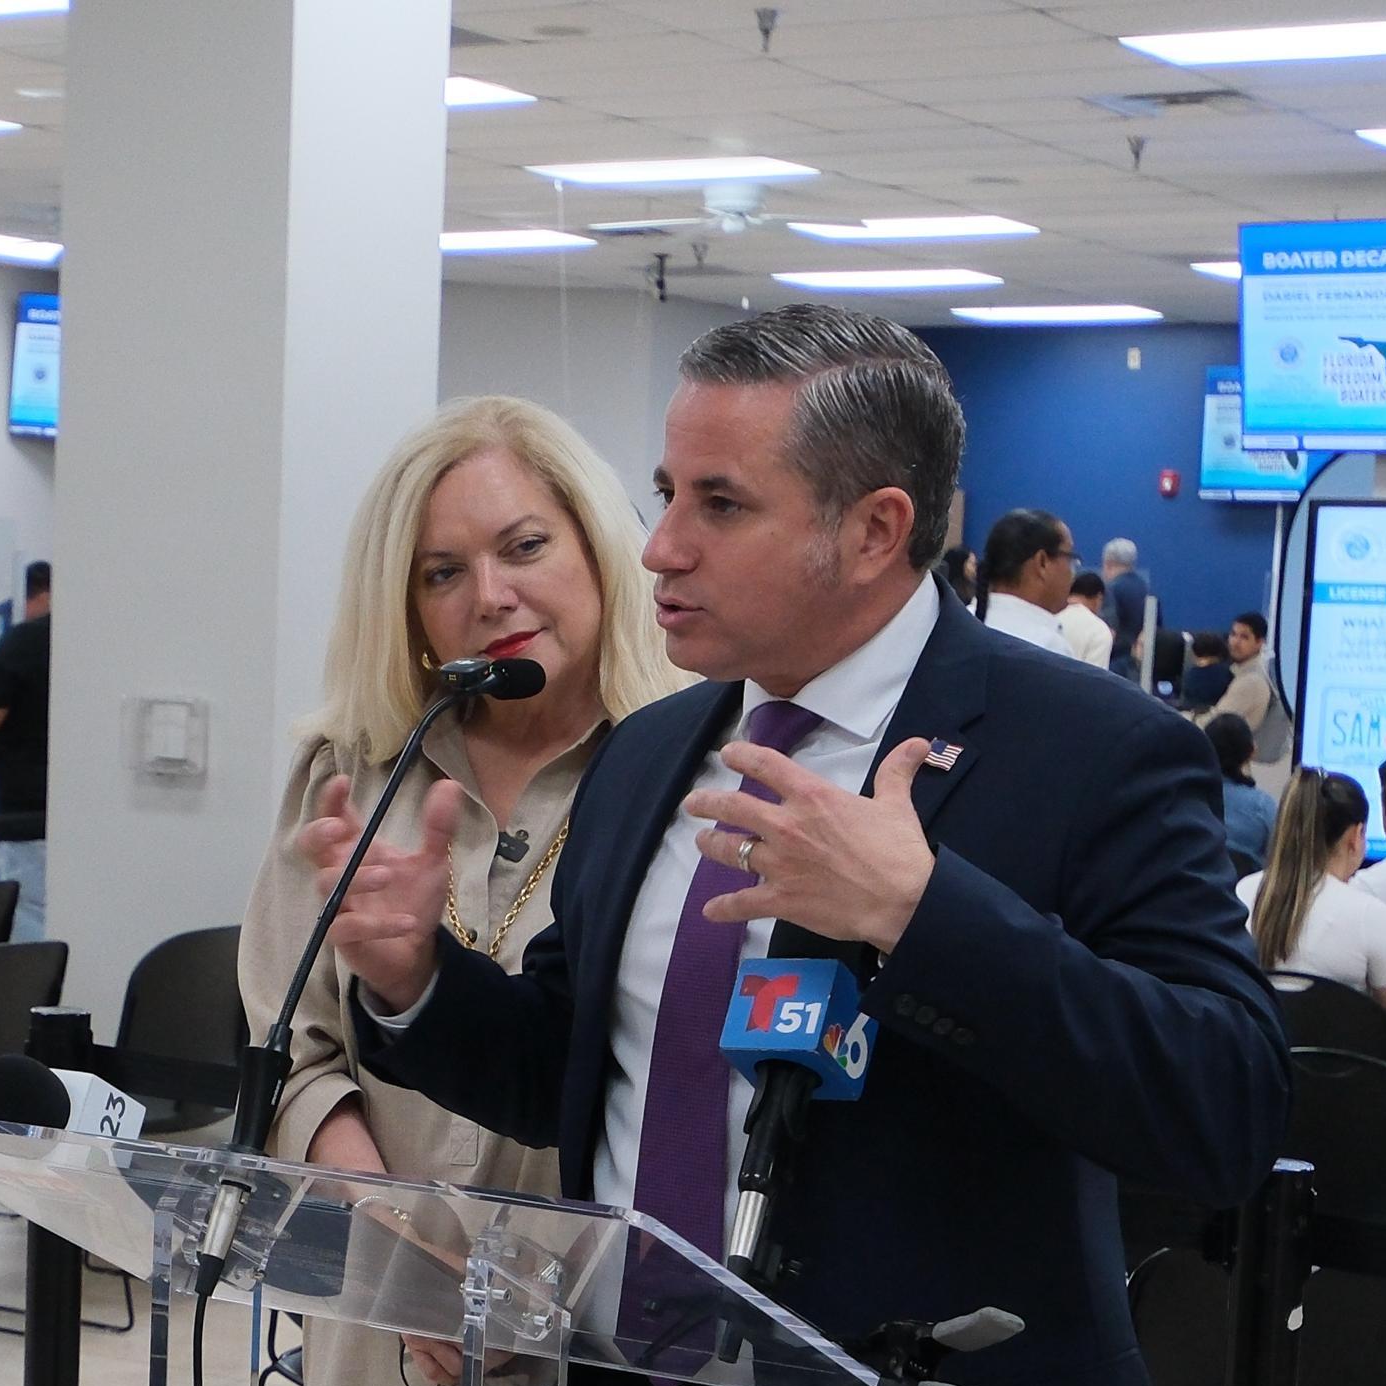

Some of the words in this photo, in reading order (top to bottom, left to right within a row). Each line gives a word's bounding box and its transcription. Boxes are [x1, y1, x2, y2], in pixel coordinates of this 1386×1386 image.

[1263, 251, 1337, 270] BOATER
[1328, 585, 1386, 600] LICENSE
[775, 1002, 822, 1034] 51
[843, 1012, 870, 1079] 6
[100, 1091, 125, 1136] 23
